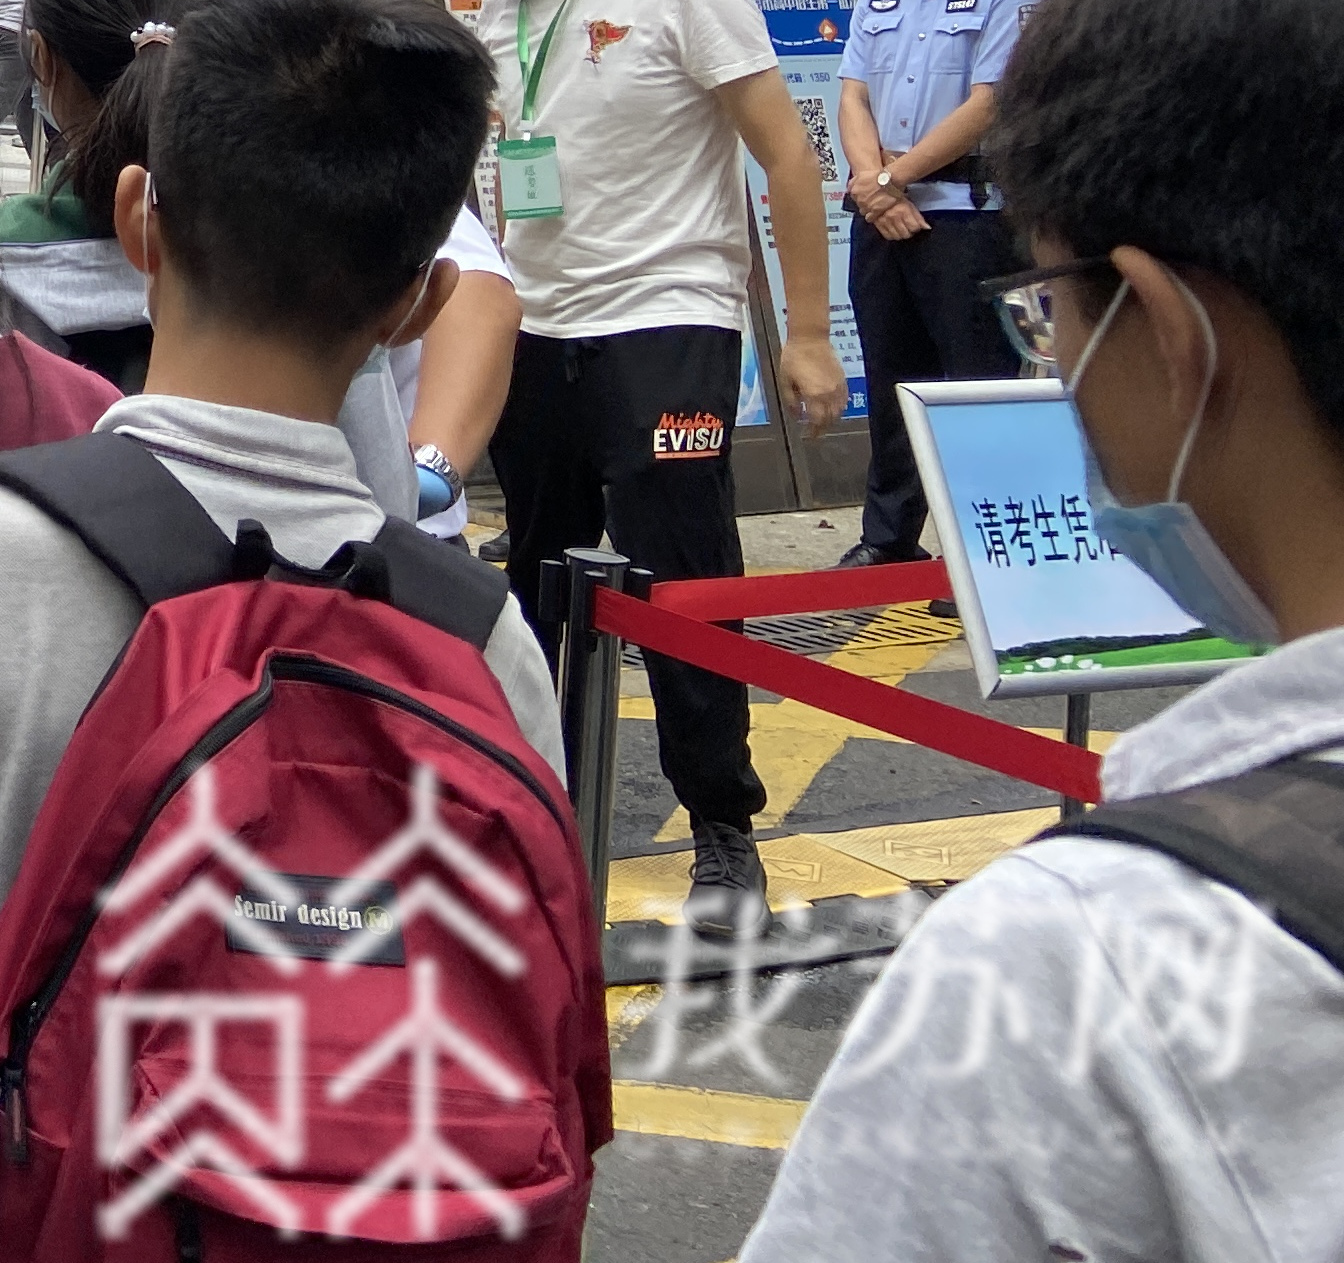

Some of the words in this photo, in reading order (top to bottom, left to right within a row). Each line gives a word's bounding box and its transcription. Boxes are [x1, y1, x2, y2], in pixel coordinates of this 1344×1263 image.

[657, 411, 724, 432] Mighty
[653, 427, 724, 452] EVISU
[233, 894, 288, 923] Semir
[296, 903, 363, 931] design
